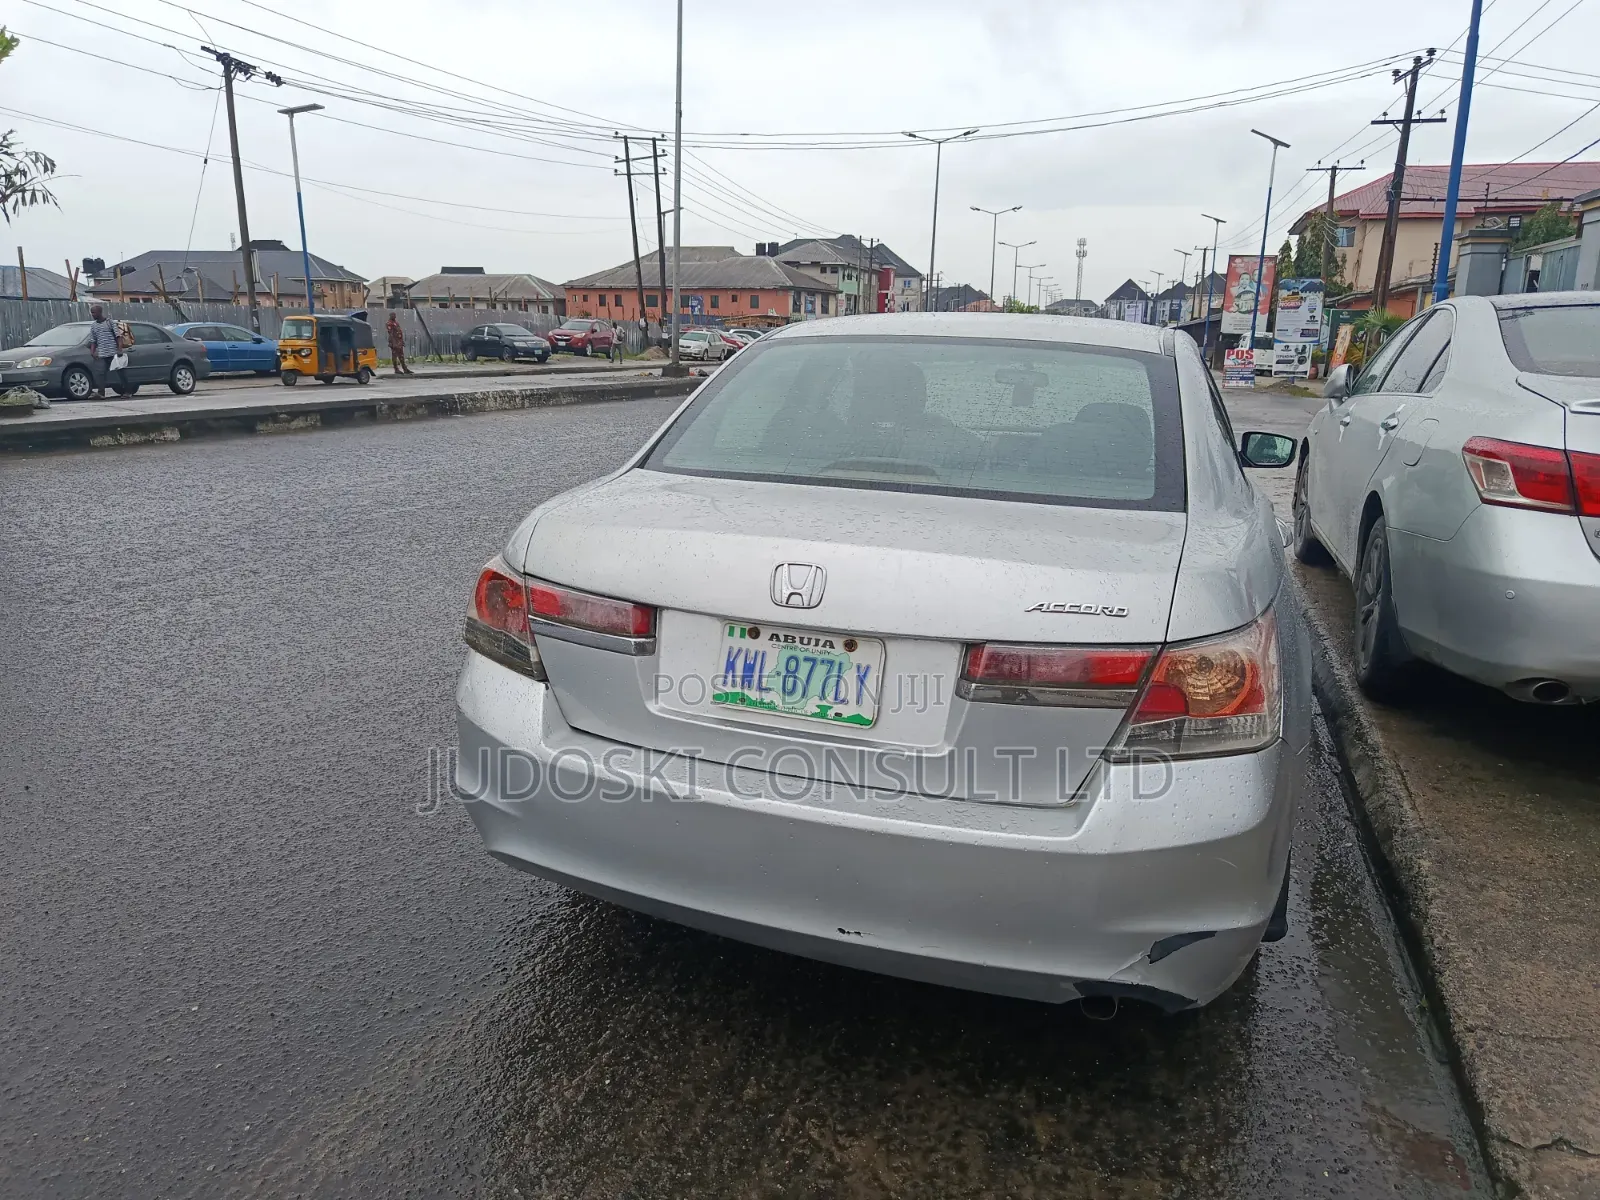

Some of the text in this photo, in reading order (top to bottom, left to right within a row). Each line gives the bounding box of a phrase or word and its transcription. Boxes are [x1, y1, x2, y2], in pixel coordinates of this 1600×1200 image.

[1226, 350, 1254, 360] POS
[1024, 601, 1129, 617] ACCORD
[768, 632, 836, 650] ABUJA
[771, 643, 832, 656] CENTRE OF UNITY
